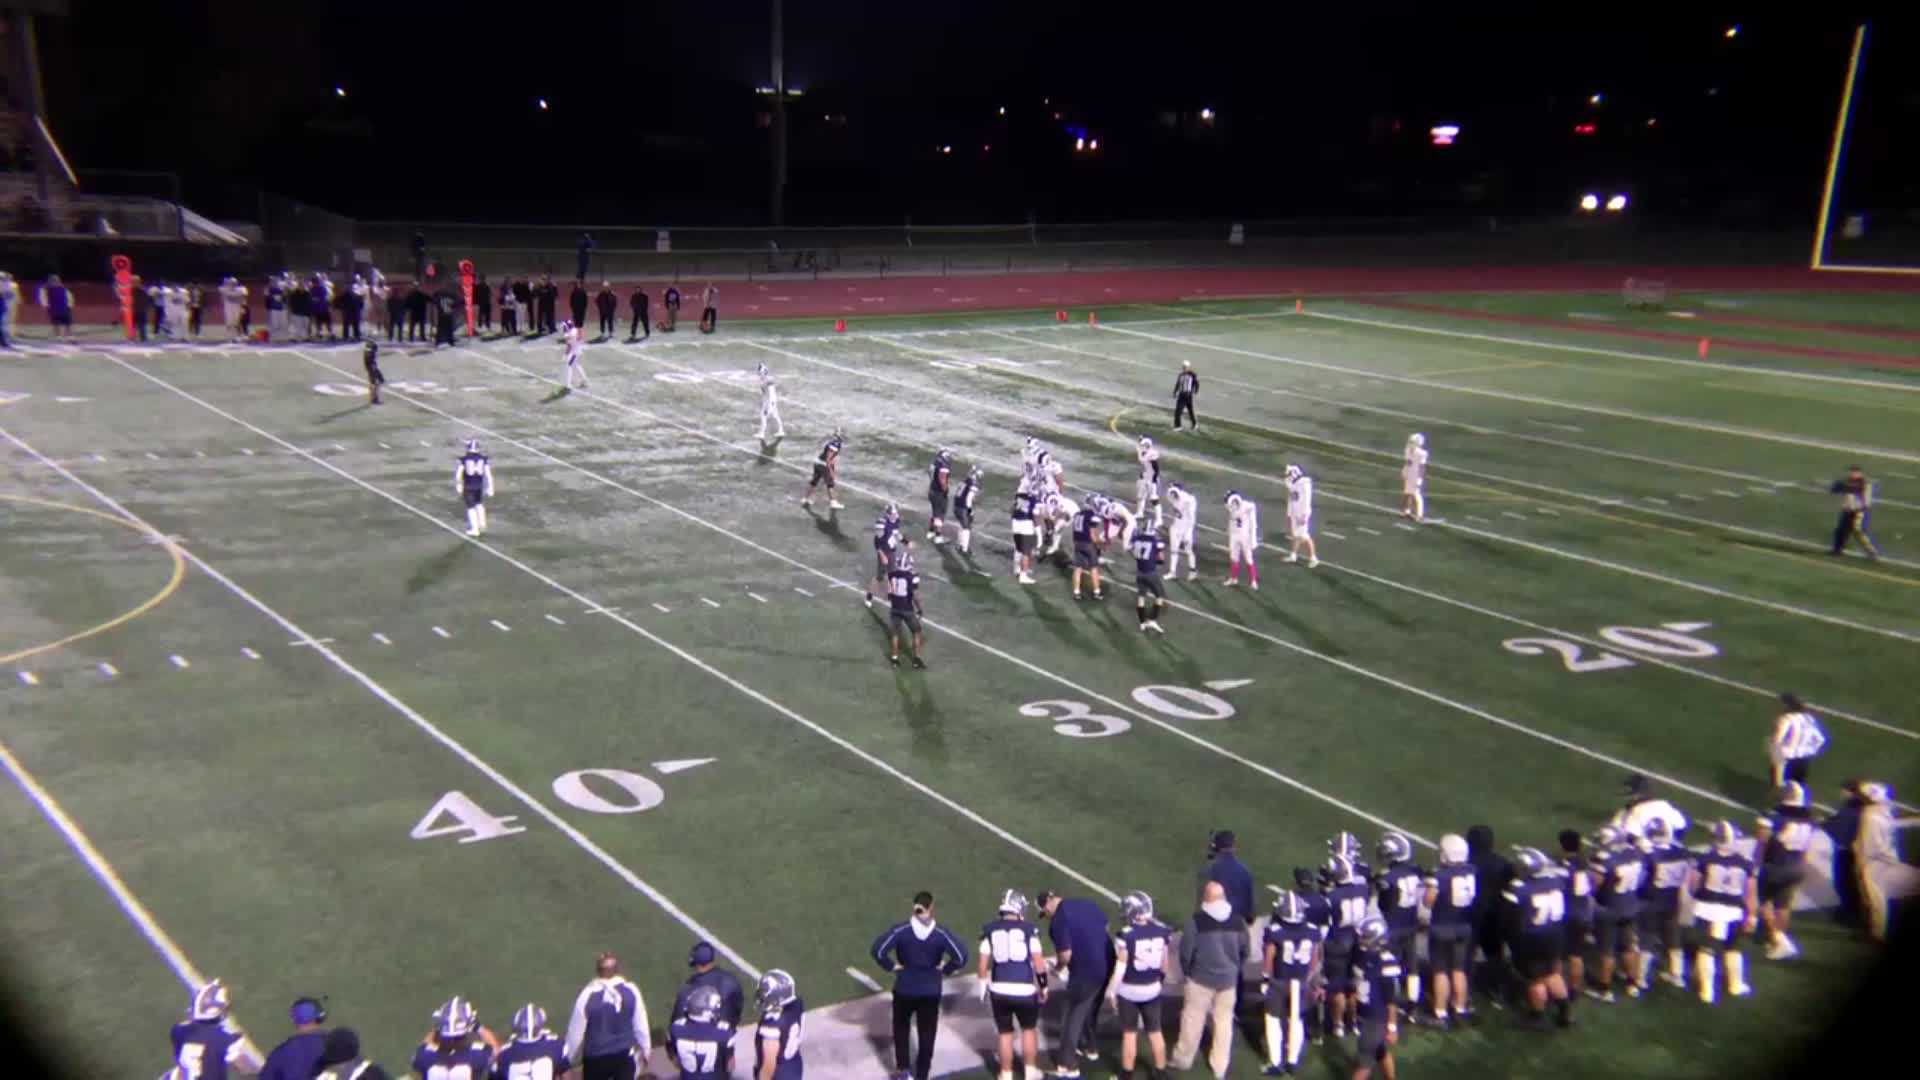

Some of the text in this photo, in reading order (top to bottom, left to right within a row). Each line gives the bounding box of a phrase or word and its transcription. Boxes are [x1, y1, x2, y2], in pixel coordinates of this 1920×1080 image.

[1502, 626, 1717, 672] 20
[1019, 685, 1235, 737] 30
[410, 768, 665, 843] 40
